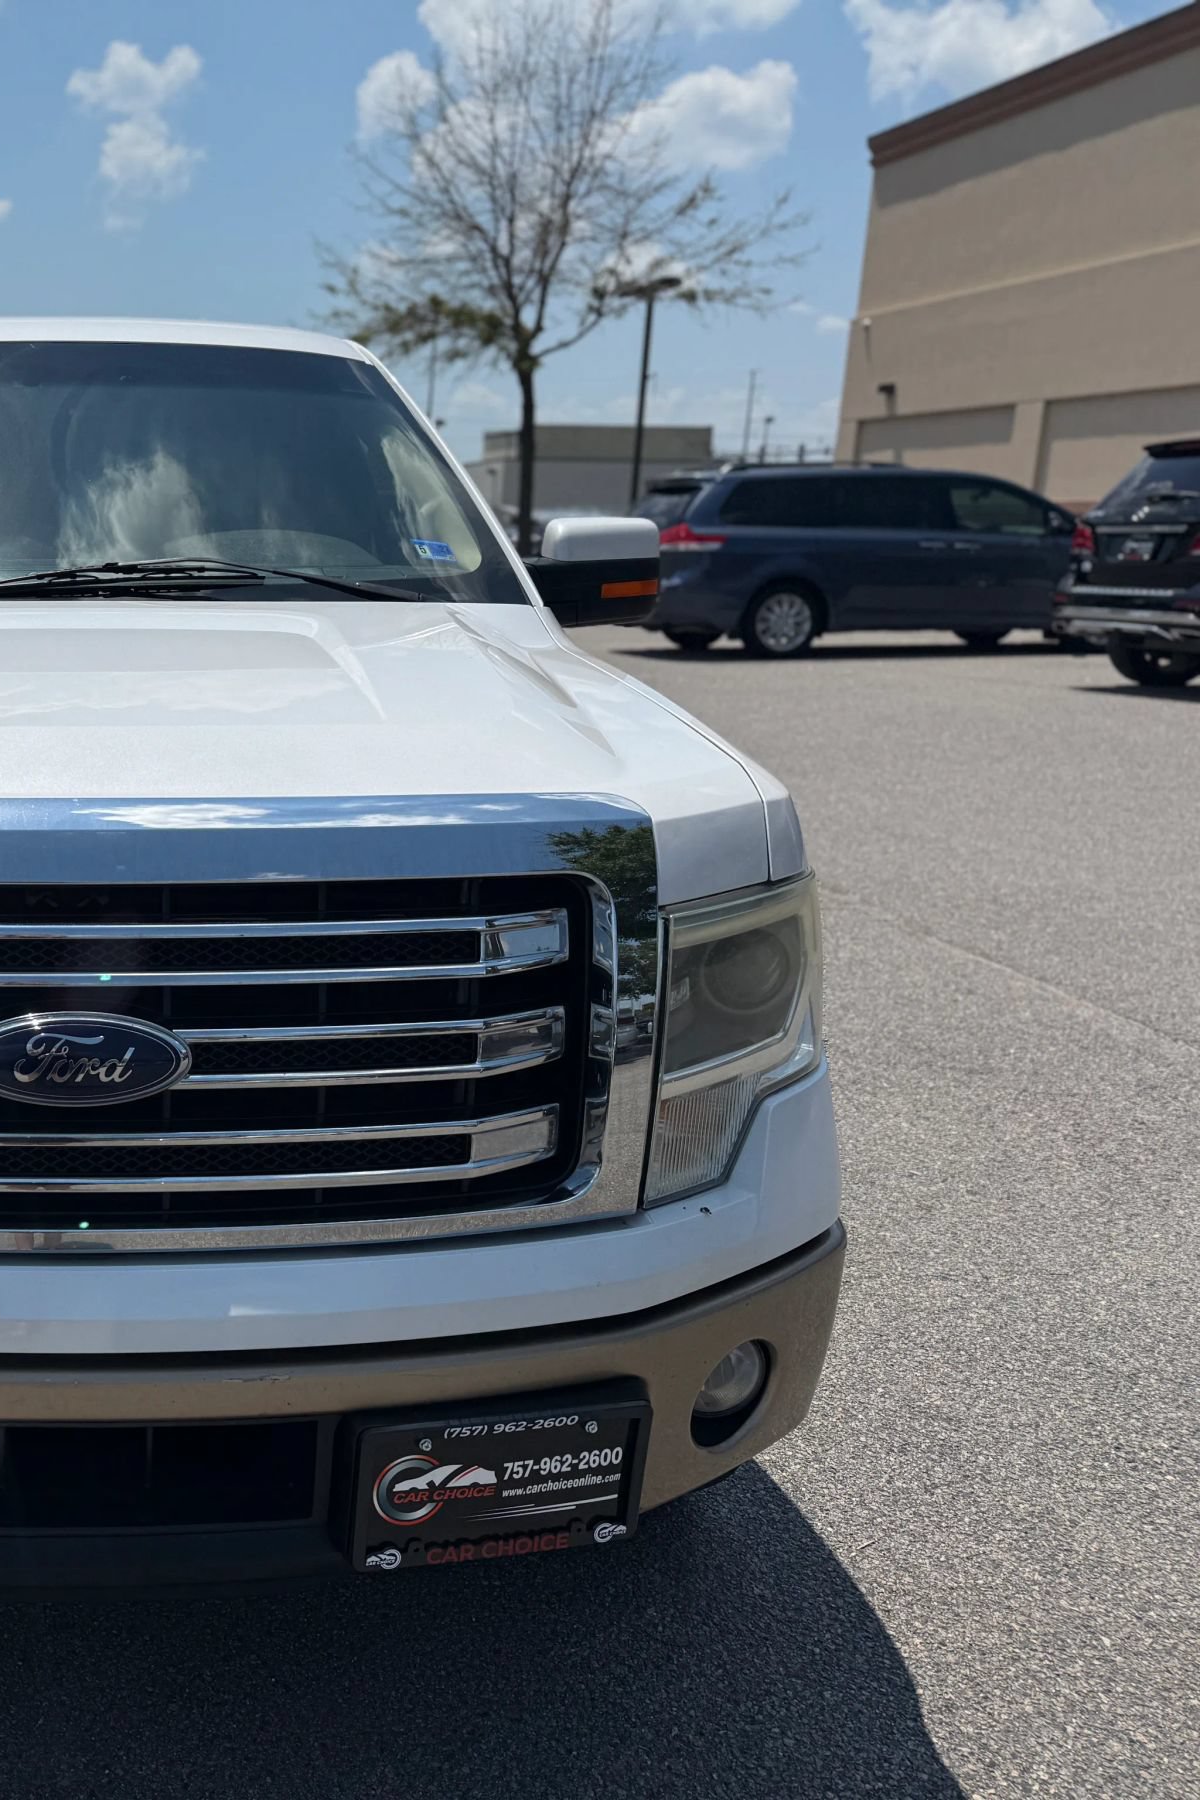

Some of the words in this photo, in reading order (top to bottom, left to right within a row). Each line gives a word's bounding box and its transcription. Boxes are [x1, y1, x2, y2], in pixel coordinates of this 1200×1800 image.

[13, 1033, 135, 1083] Ford
[444, 1425, 488, 1439] (757)
[493, 1415, 579, 1434] 962-2600
[503, 1446, 623, 1480] 757-962-2600
[394, 1491, 429, 1504] CAR
[433, 1486, 496, 1500] CHOICE
[502, 1473, 621, 1497] www.carchoiceonline.com
[426, 1543, 474, 1565] CAR
[481, 1532, 570, 1559] CHOICE
